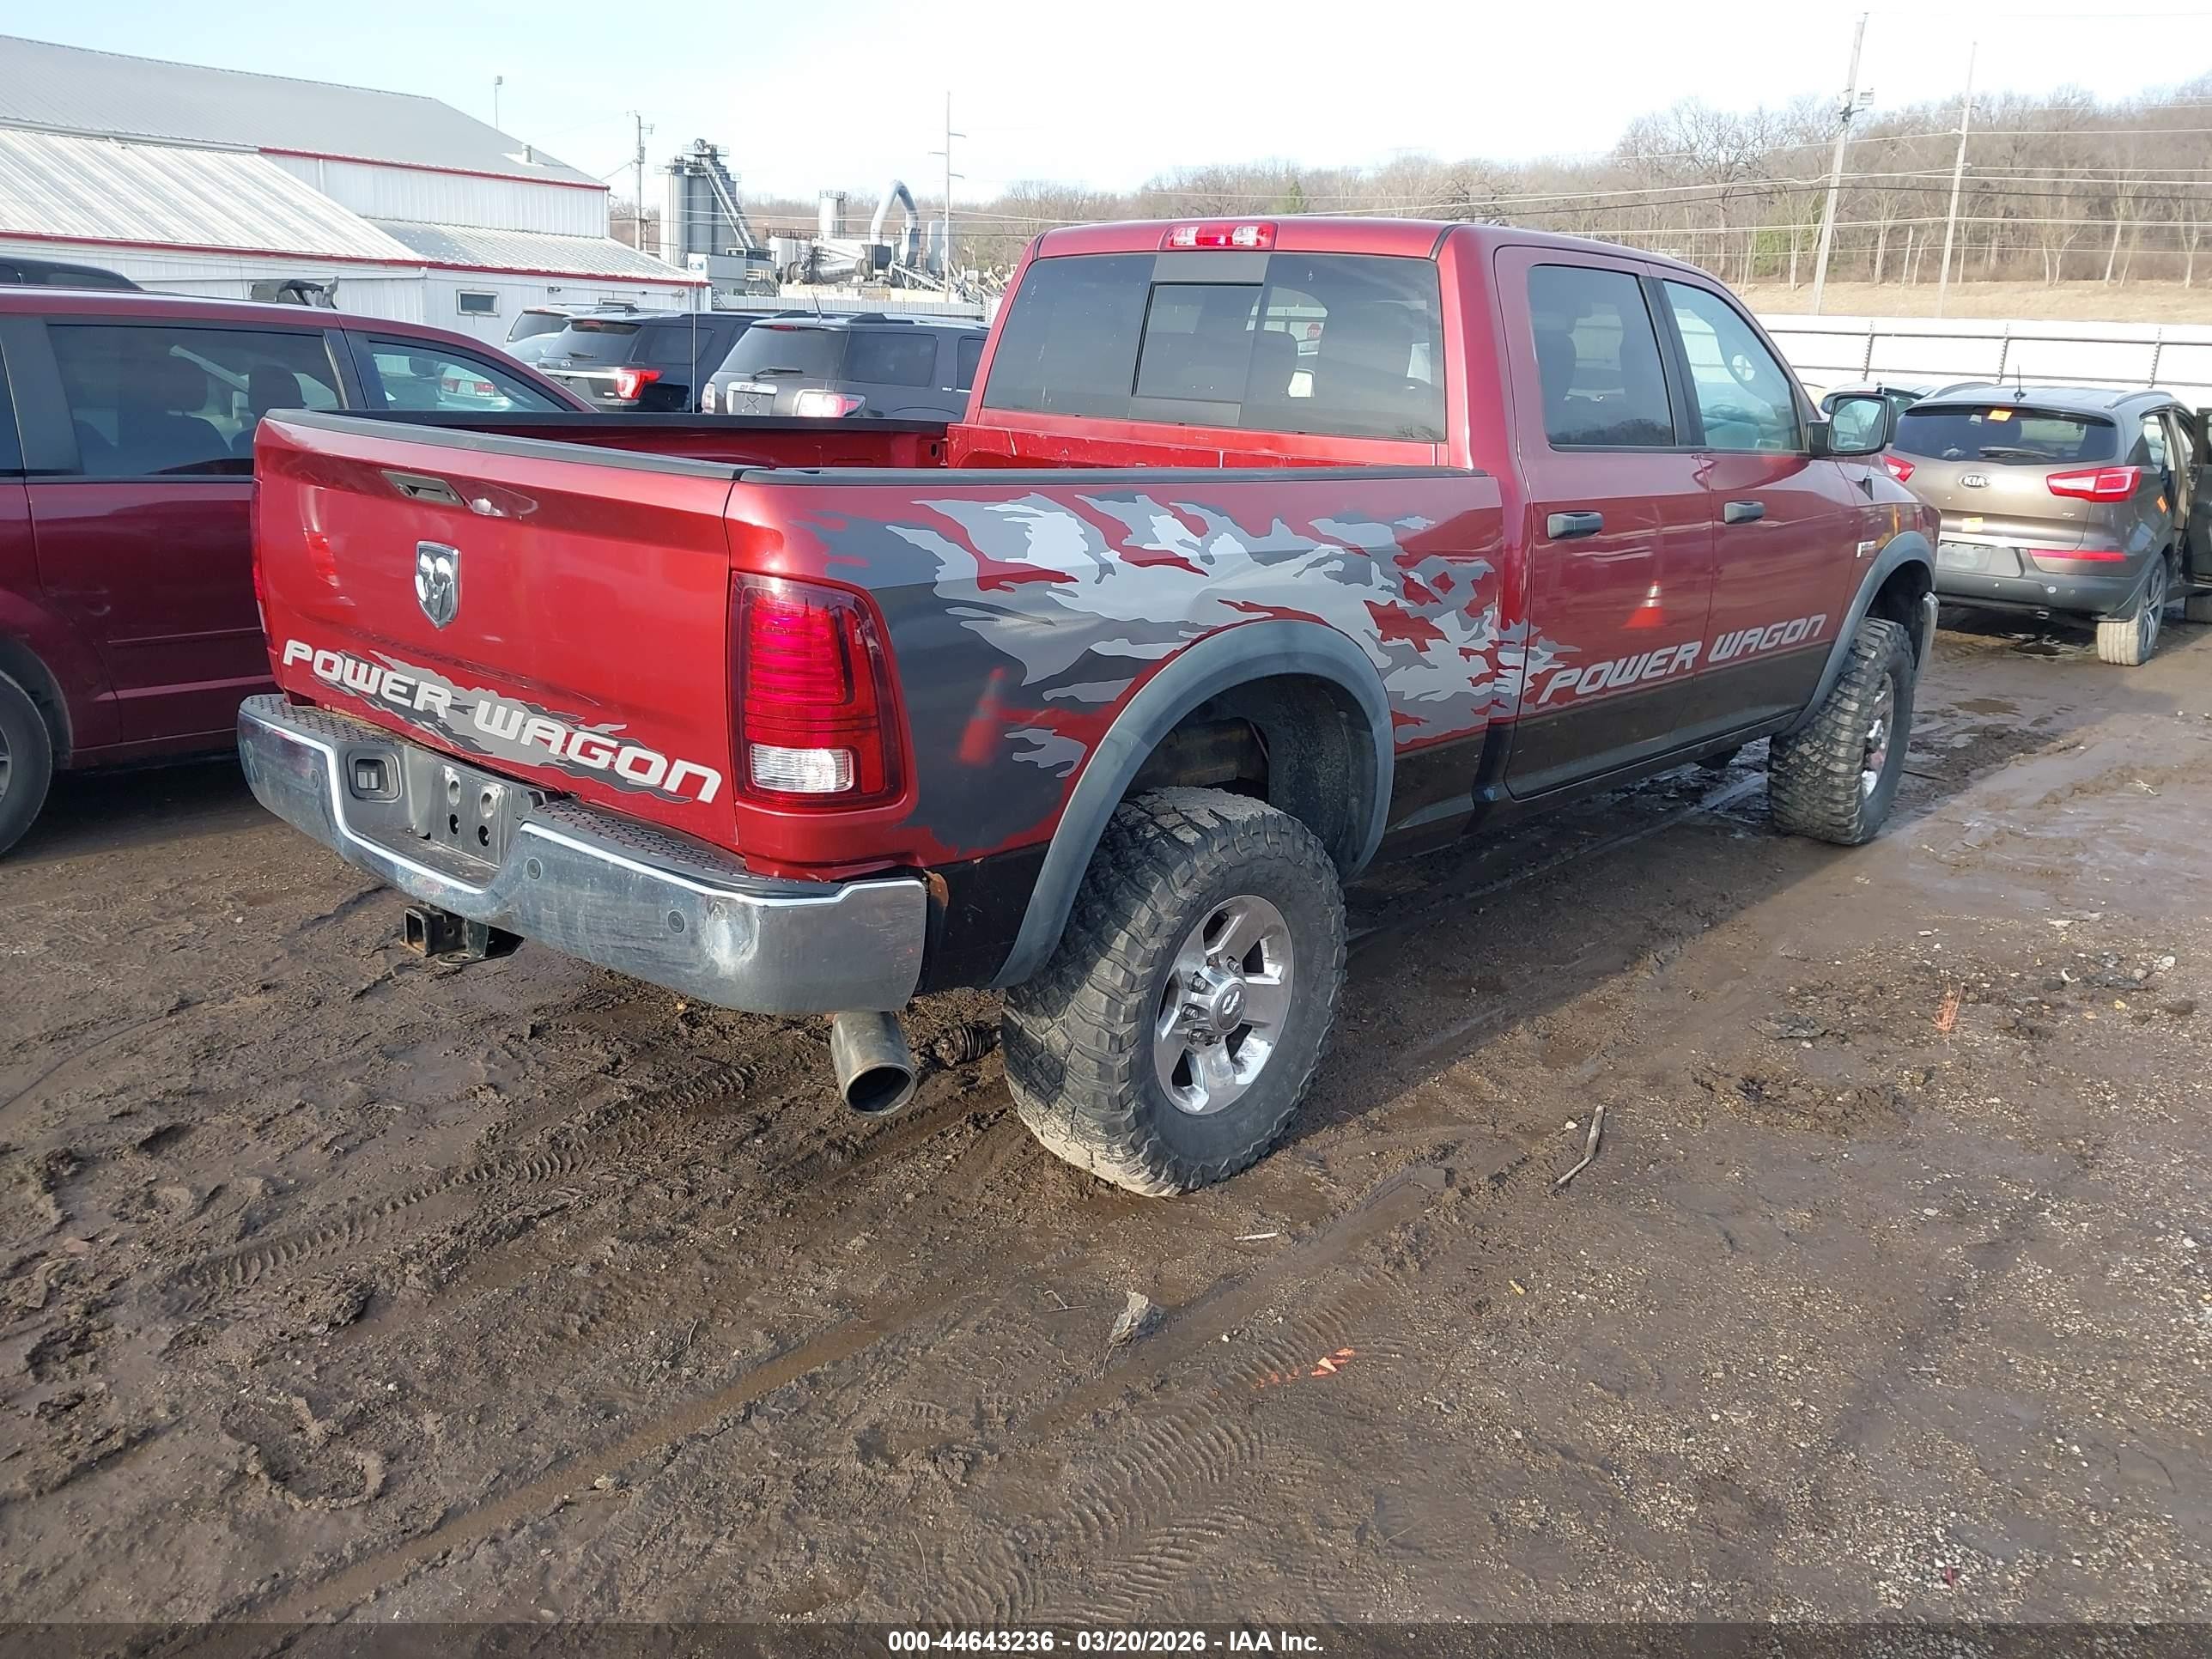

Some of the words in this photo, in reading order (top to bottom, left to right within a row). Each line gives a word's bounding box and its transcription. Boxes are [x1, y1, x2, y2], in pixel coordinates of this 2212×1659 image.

[283, 639, 454, 720] POWER
[472, 699, 723, 804] WAGON
[1538, 641, 1704, 704] POWER
[1707, 613, 1827, 663] WAGON
